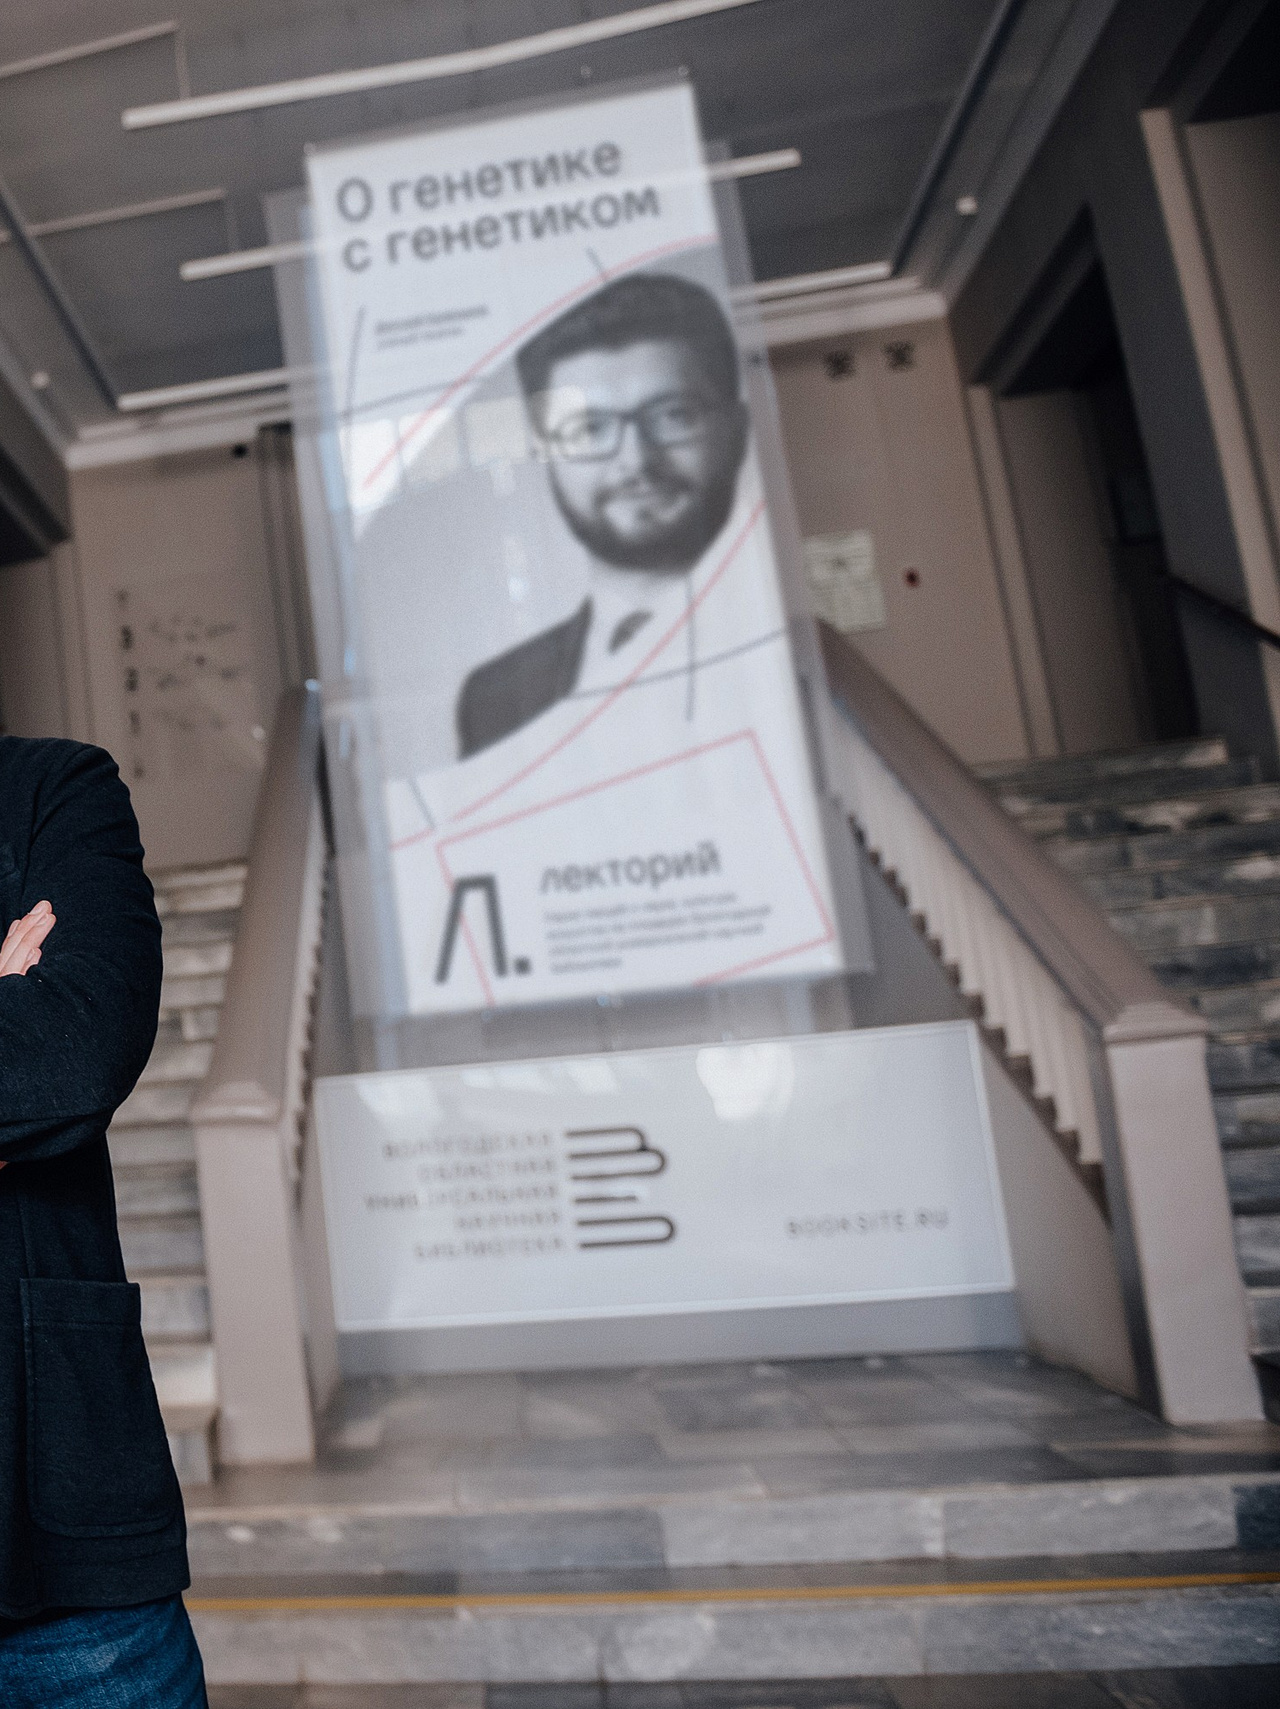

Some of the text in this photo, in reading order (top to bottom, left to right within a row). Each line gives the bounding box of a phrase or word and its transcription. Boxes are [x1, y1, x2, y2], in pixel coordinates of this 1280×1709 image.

[335, 140, 623, 224] О генетике
[341, 184, 663, 273] с генетиком
[540, 839, 723, 894] лекторий
